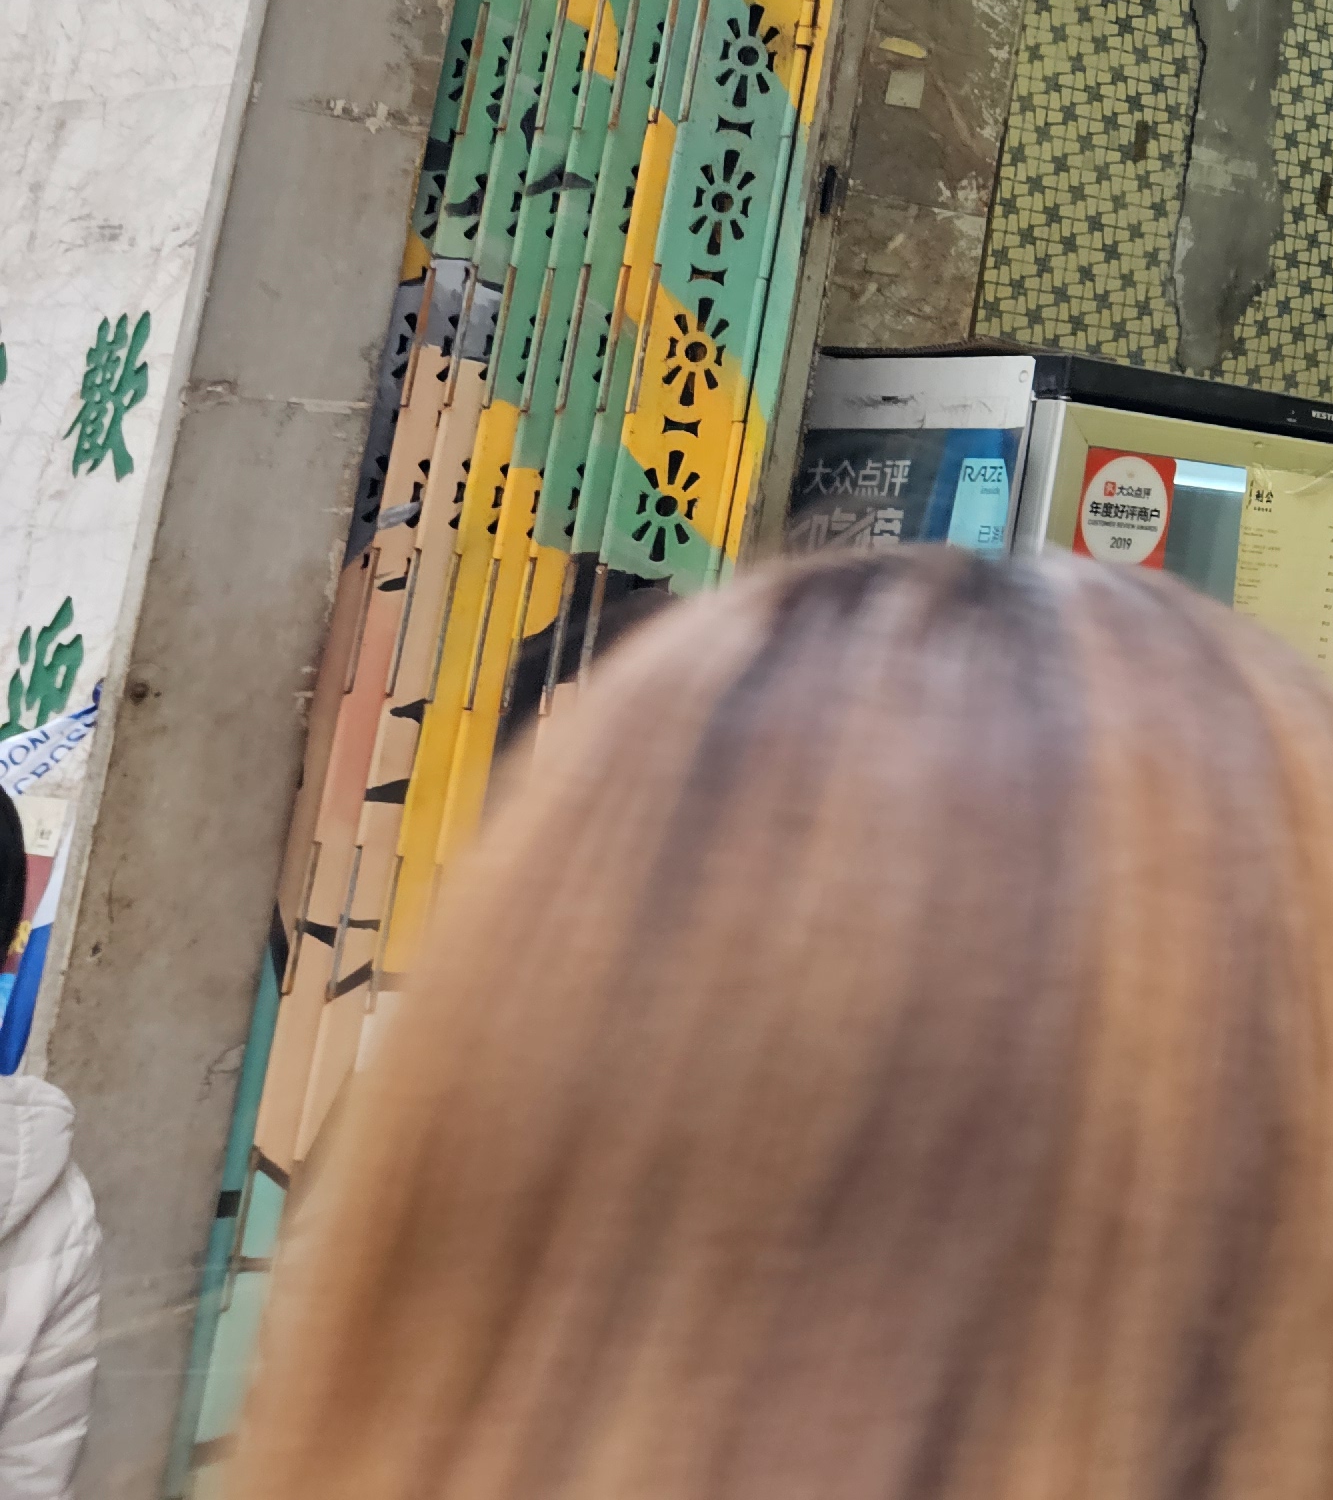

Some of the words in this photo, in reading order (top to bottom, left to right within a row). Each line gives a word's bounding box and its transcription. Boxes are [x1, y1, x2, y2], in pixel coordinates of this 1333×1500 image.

[803, 457, 911, 497] 大众点评
[1116, 484, 1152, 499] 大众点评
[1089, 500, 1160, 523] 年度好评商户
[1109, 536, 1132, 550] 2019
